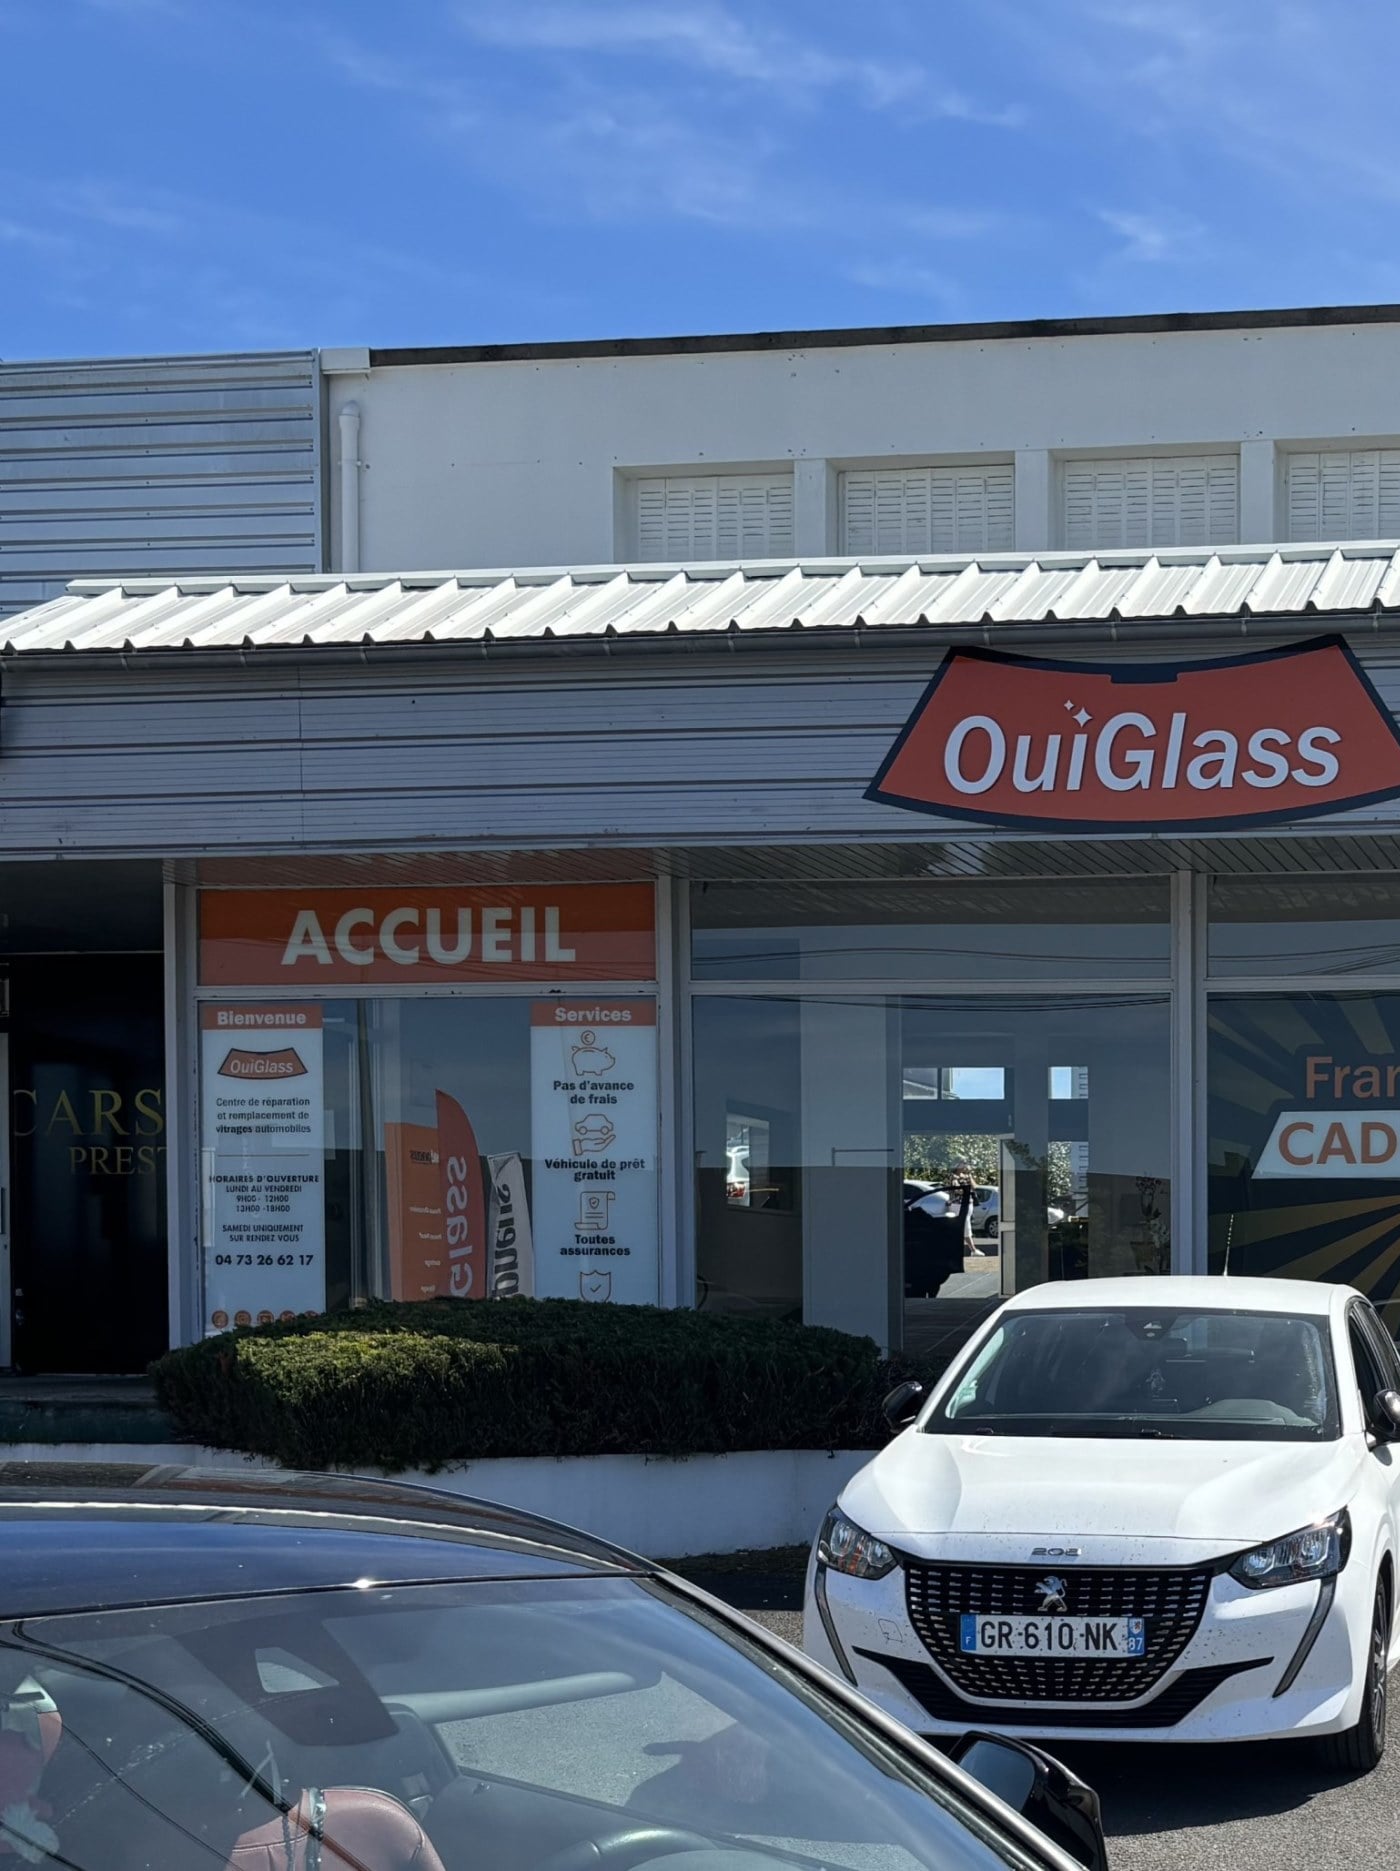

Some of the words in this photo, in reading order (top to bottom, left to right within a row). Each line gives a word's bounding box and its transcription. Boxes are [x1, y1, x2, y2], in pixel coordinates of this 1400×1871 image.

[943, 702, 1342, 795] OuiGlass
[281, 906, 576, 966] ACCUEIL
[217, 1011, 307, 1026] Bienvenue
[555, 1007, 632, 1023] Services
[230, 1059, 294, 1074] OuiGlass
[553, 1081, 576, 1092] Pas
[579, 1080, 635, 1092] d'avance
[216, 1097, 246, 1107] Centre
[248, 1097, 259, 1107] de
[262, 1097, 310, 1108] réparation
[570, 1093, 586, 1104] de
[588, 1093, 618, 1104] frais
[13, 1088, 165, 1136] CARS
[217, 1111, 226, 1120] et
[228, 1110, 295, 1121] remplacement
[298, 1110, 309, 1120] de
[216, 1124, 252, 1135] vitrages
[255, 1123, 311, 1134] automobiles
[545, 1158, 597, 1170] Véhicule
[601, 1158, 616, 1170] de
[620, 1158, 645, 1172] prêt
[209, 1175, 254, 1183] HORAIRES
[257, 1175, 320, 1183] D'OUVERTURE
[574, 1169, 616, 1181] gratuit
[226, 1185, 250, 1193] LUNDI
[251, 1185, 262, 1193] AU
[264, 1185, 302, 1193] VENDREDI
[265, 1194, 290, 1203] 12H00
[222, 1224, 251, 1233] SAMEDI
[253, 1224, 304, 1233] UNIQUEMENT
[229, 1235, 244, 1243] SUR
[246, 1235, 275, 1243] RENDEZ
[277, 1235, 299, 1243] VOUS
[574, 1234, 616, 1245] Toutes
[560, 1247, 631, 1257] assurances
[215, 1254, 232, 1266] 04
[236, 1254, 253, 1266] 73
[257, 1254, 273, 1266] 26
[277, 1254, 294, 1266] 62
[299, 1254, 314, 1266] 17
[1031, 1547, 1082, 1557] 208
[965, 1636, 971, 1645] F
[981, 1621, 1117, 1651] GR-610-NK
[1128, 1637, 1143, 1651] 87
